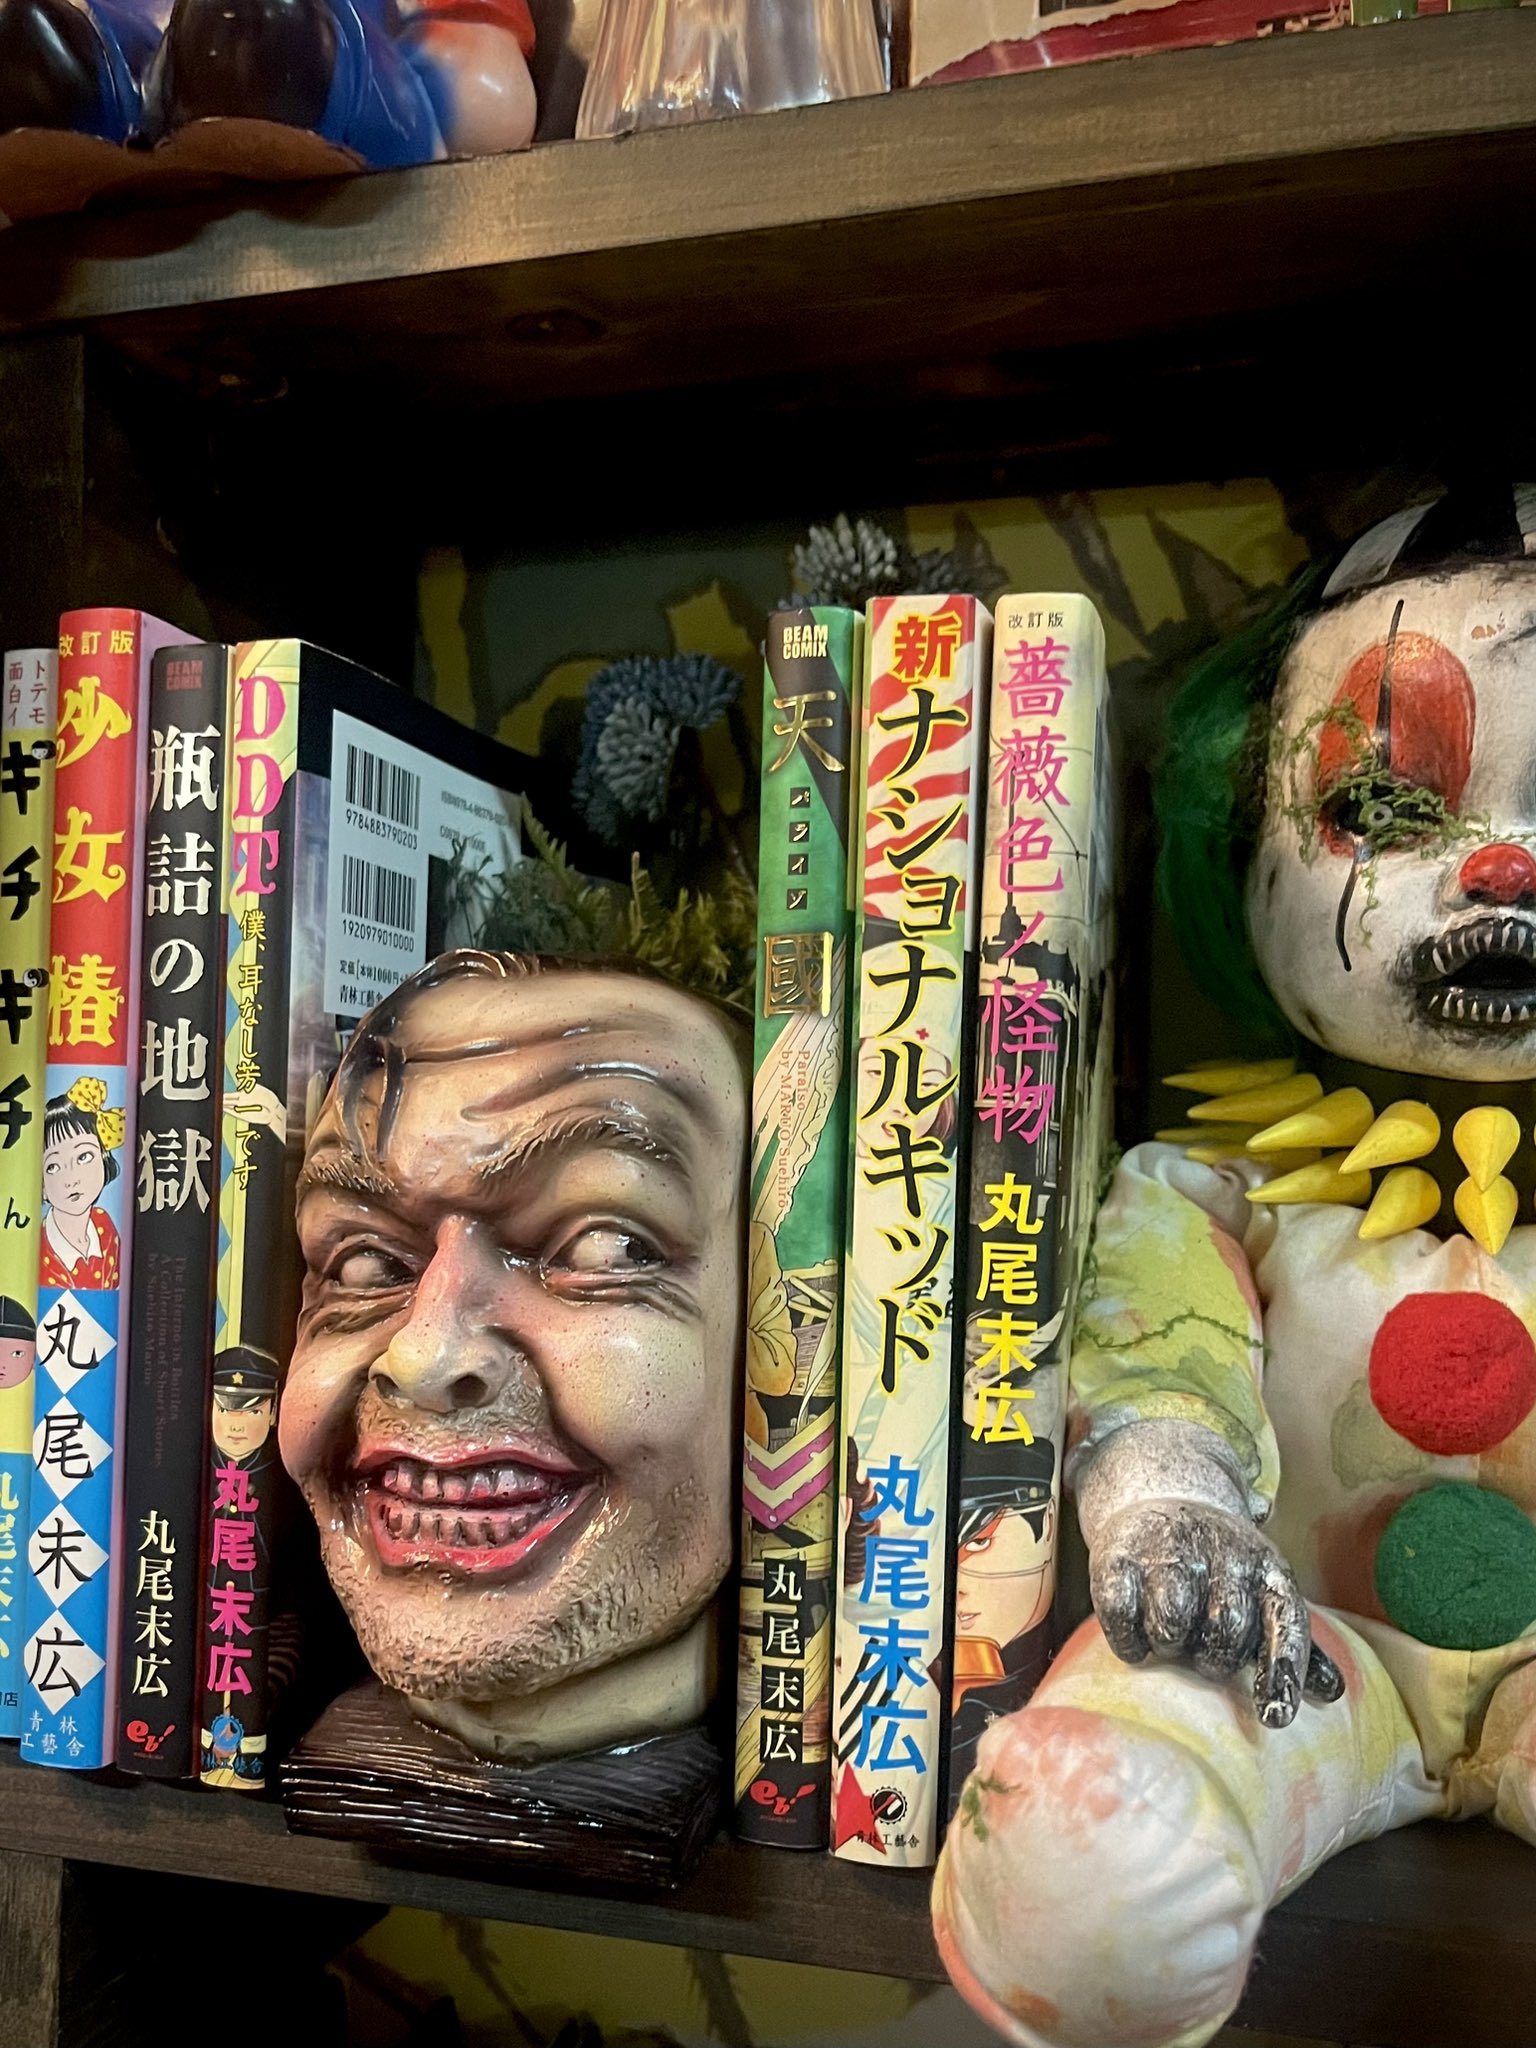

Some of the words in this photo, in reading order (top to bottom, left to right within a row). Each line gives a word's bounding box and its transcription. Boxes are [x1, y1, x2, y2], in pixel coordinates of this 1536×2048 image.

[8, 662, 24, 727] 面白イ
[29, 660, 47, 725] トテモ
[59, 630, 135, 657] 改訂版
[783, 625, 829, 642] BEAM
[783, 641, 827, 660] COMIX
[1008, 611, 1065, 629] 改訂版
[49, 676, 133, 1047] 少女椿
[232, 676, 287, 896] DDT
[345, 808, 419, 851] 9784883790203
[138, 724, 222, 1213] 瓶詰の地獄
[342, 918, 415, 953] 1920979010000
[978, 637, 1073, 1144] 薔薇色ノ怪物
[233, 909, 268, 1190] 僕、耳なし芳一です
[780, 1050, 793, 1070] by
[970, 1171, 1044, 1446] 丸尾末広
[27, 1303, 100, 1698] 丸尾末広
[206, 1462, 260, 1696] 丸尾末広
[132, 1509, 176, 1698] 丸尾末広
[763, 1561, 803, 1763] 丸尾末広
[853, 1455, 935, 1775] 丸尾末広
